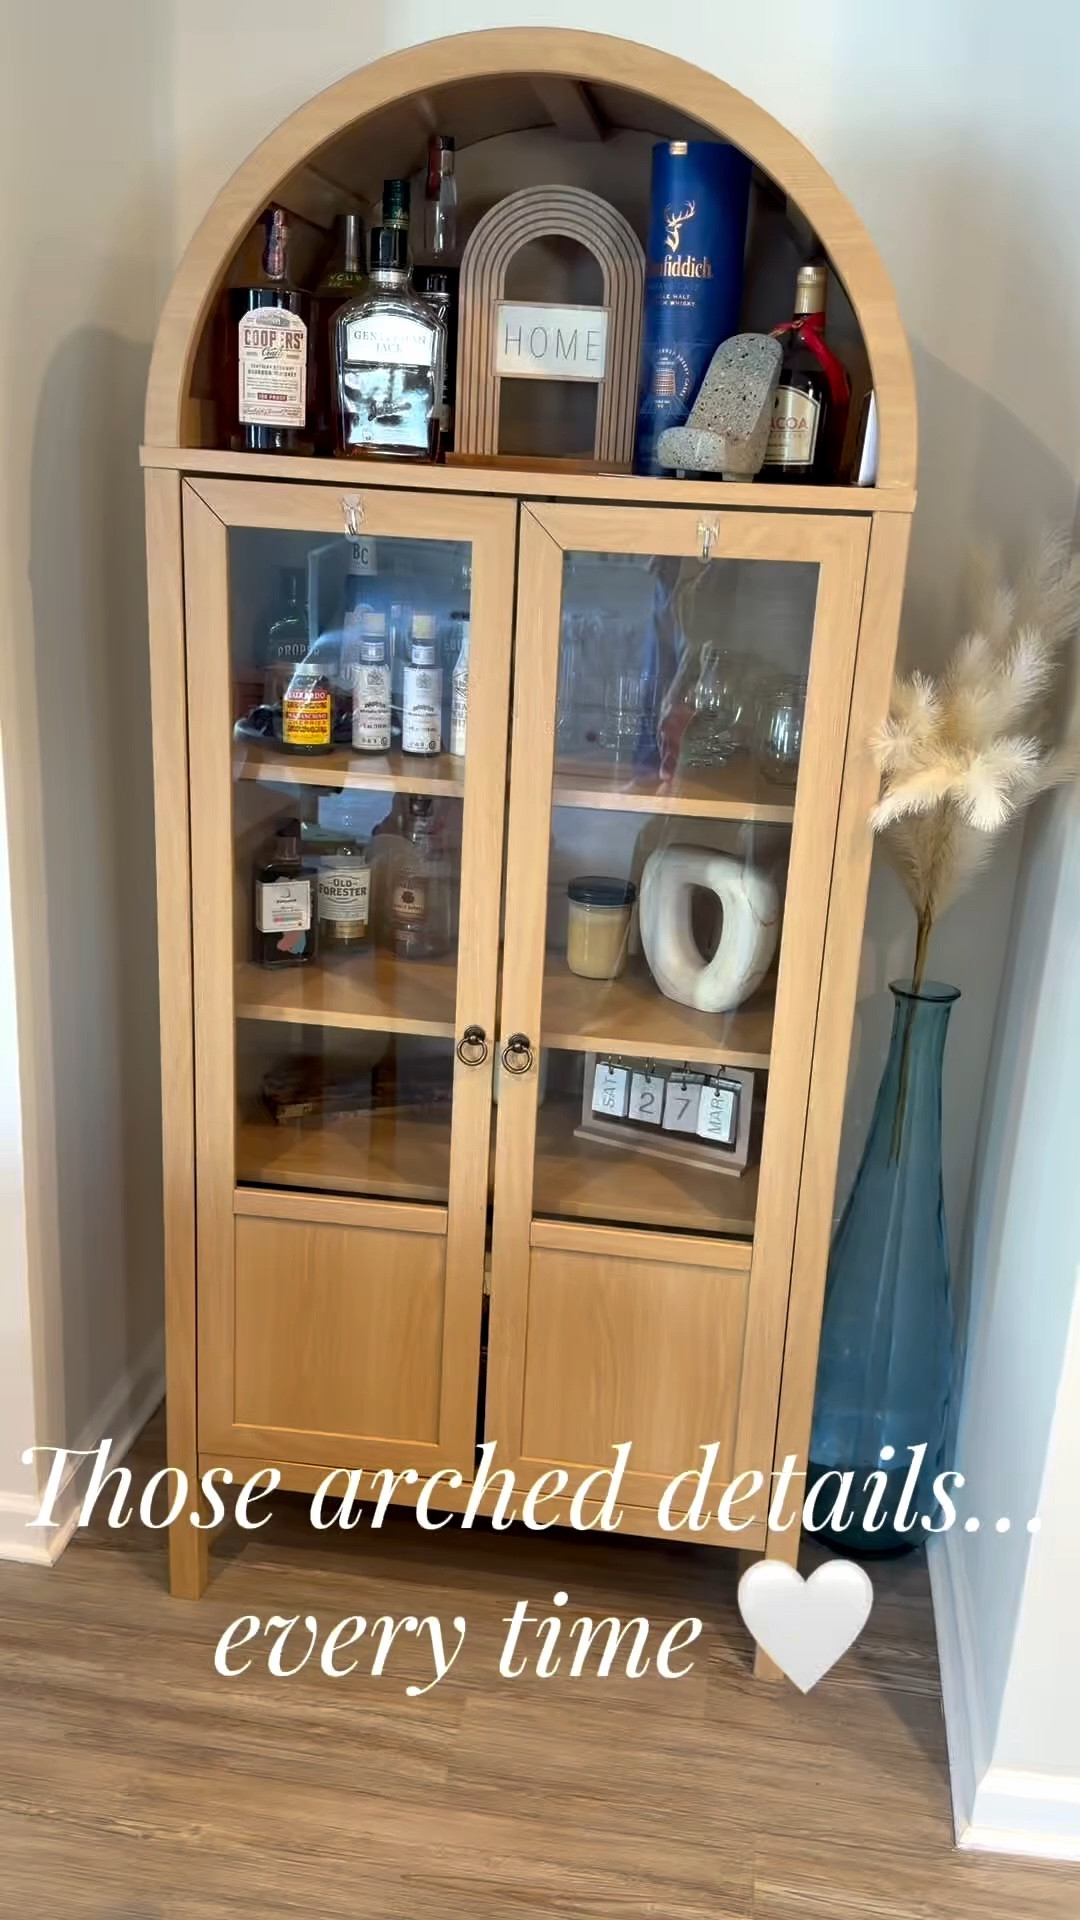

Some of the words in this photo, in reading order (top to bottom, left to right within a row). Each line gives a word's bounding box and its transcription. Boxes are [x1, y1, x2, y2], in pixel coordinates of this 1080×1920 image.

[505, 323, 601, 361] HOME
[319, 884, 367, 897] FORESTER
[333, 878, 353, 888] OLD
[602, 1077, 617, 1109] SAT
[638, 1092, 655, 1115] 2
[675, 1097, 691, 1121] 7
[708, 1097, 726, 1135] MAR
